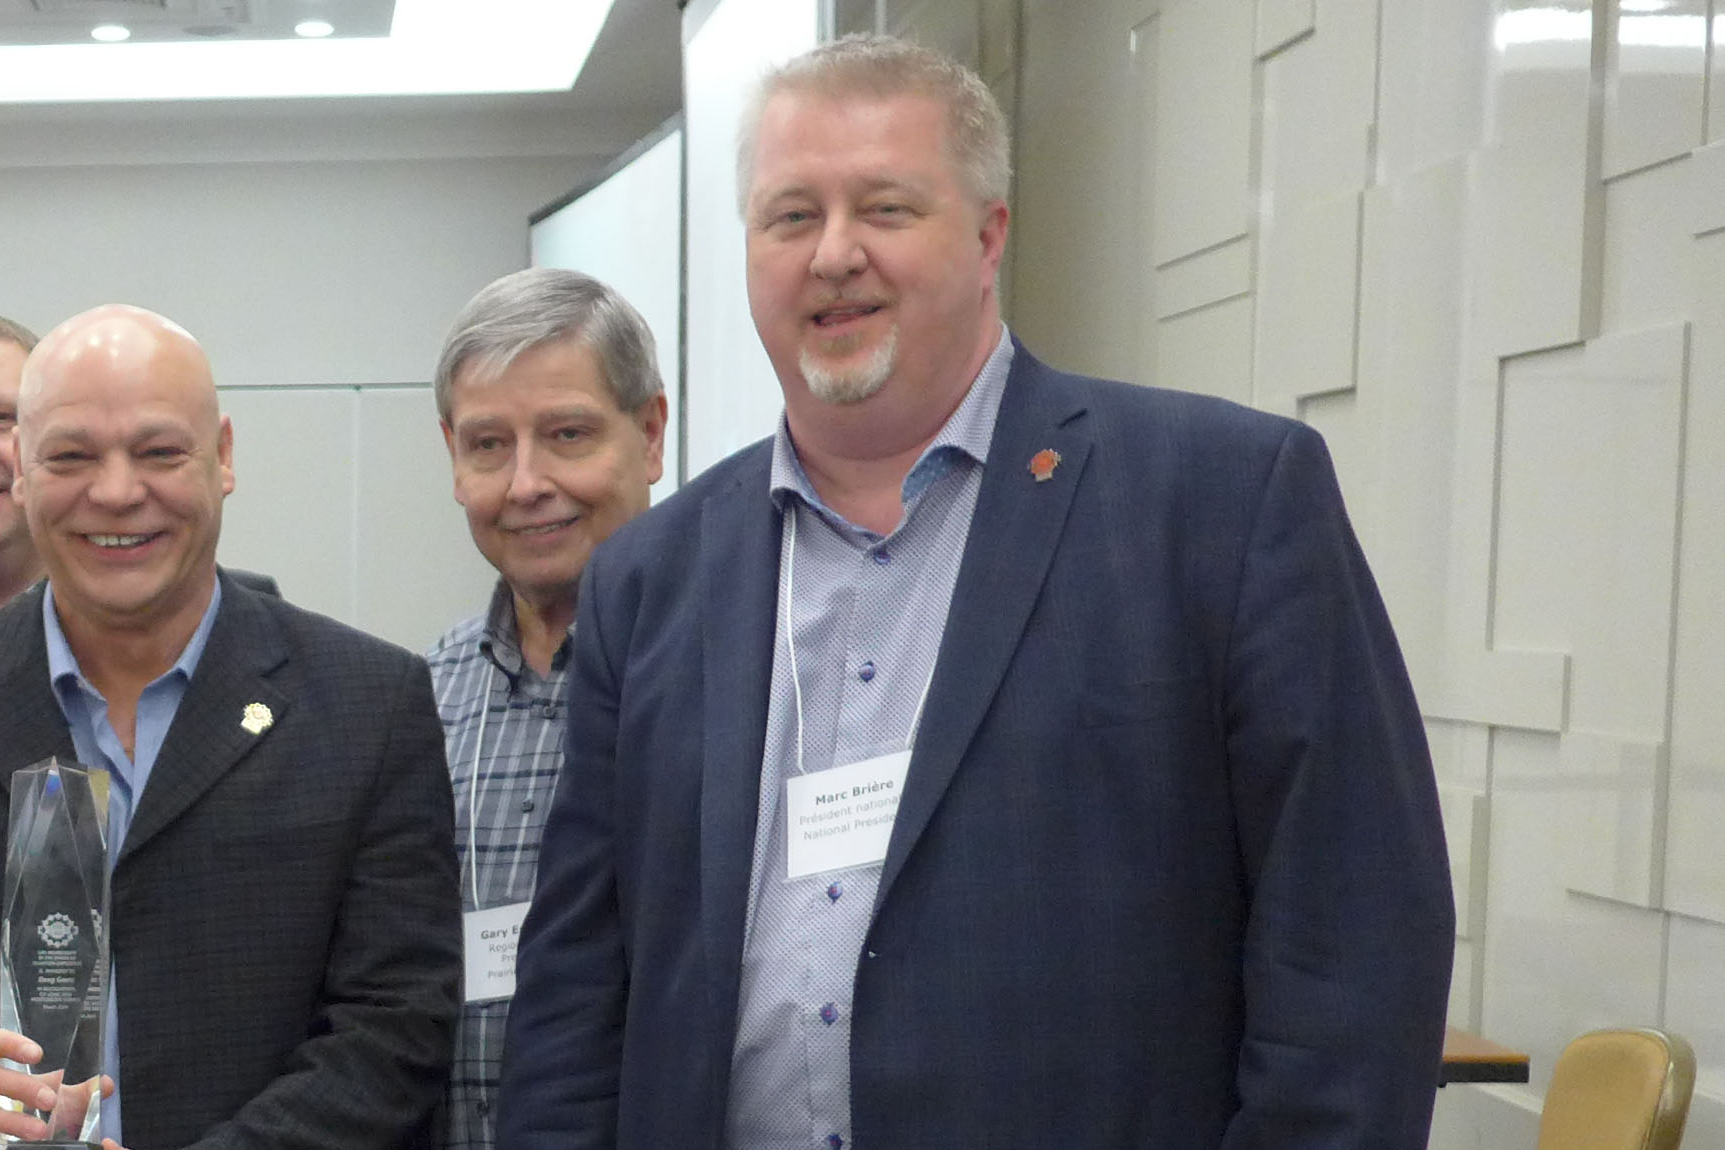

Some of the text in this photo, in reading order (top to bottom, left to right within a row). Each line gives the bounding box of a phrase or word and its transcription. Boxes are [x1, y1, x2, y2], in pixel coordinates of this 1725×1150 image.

[815, 779, 894, 806] Marc Brière
[799, 806, 853, 826] Président
[803, 824, 850, 839] National
[481, 928, 508, 940] Gary
